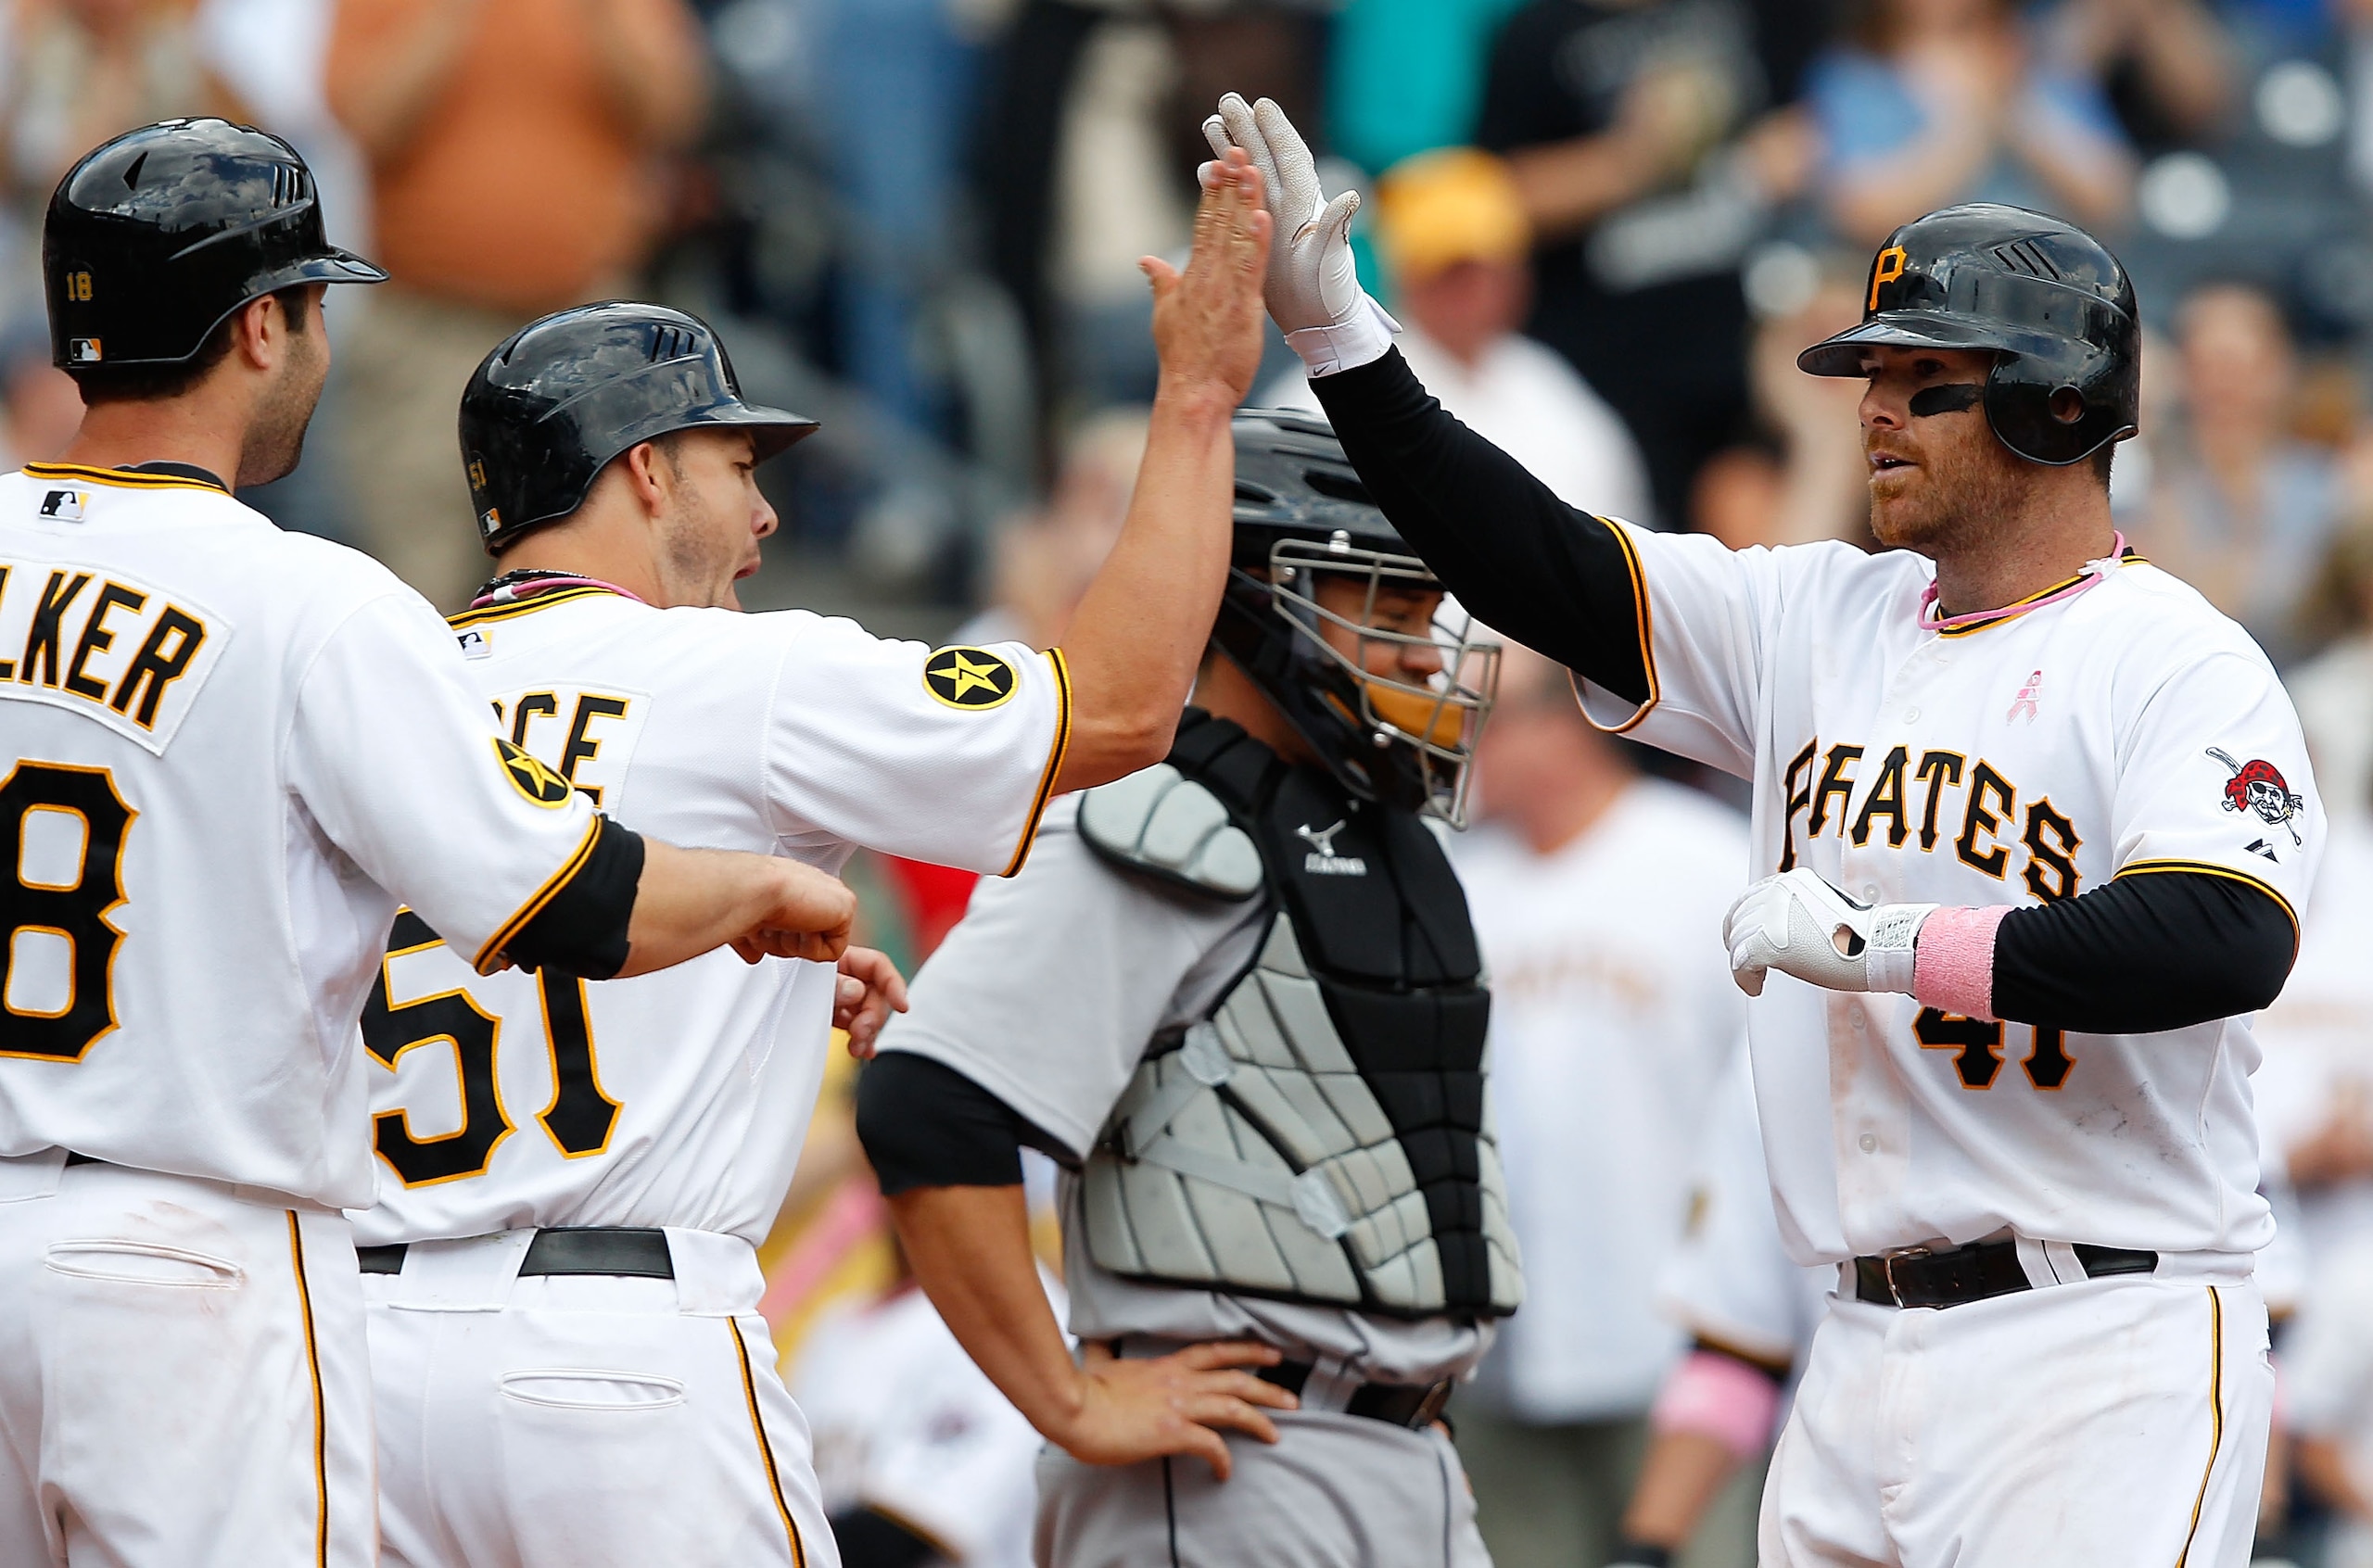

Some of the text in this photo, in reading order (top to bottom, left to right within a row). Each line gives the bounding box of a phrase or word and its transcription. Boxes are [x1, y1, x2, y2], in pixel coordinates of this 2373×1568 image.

[67, 272, 93, 301] 18
[1870, 245, 1908, 310] P
[469, 459, 487, 491] 51
[490, 690, 631, 809] CE
[360, 906, 625, 1189] 51
